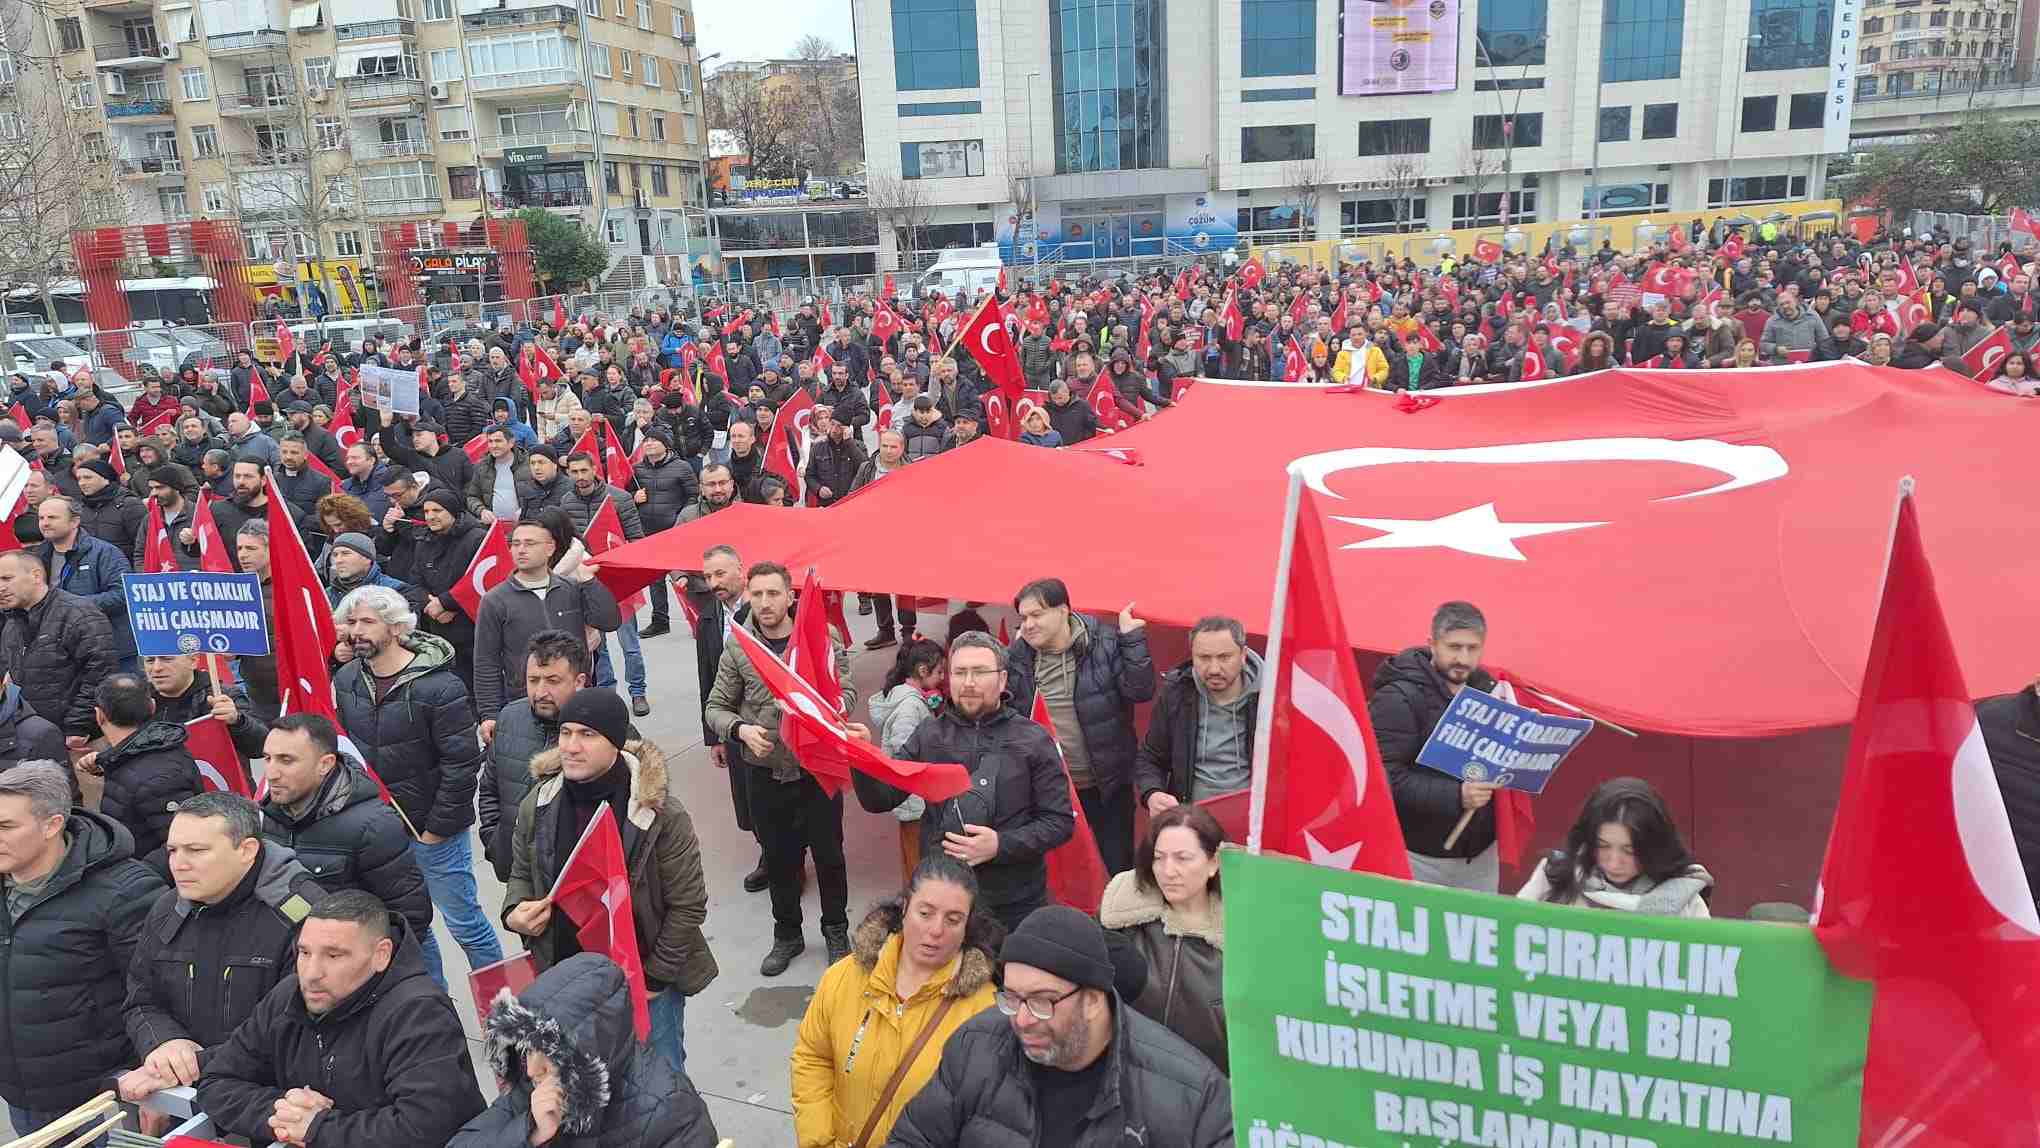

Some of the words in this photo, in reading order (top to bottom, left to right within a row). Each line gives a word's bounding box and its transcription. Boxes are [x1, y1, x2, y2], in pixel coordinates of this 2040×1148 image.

[132, 583, 166, 602] STAJ
[168, 581, 188, 601] VE
[190, 581, 254, 606] ÇIRAKLIK
[135, 607, 169, 631] FİİLİ
[171, 610, 260, 635] ÇALIŞMADIR
[1437, 721, 1480, 751] FİİLİ
[1456, 698, 1497, 726] STAJ
[1494, 711, 1521, 735] VE
[1321, 890, 1429, 956] STAJ
[1443, 910, 1499, 967] VE
[1514, 922, 1742, 998] ÇIRAKLIK
[1324, 950, 1498, 1031] İŞLETME
[1512, 990, 1630, 1054] VEYA
[1646, 1004, 1732, 1067] BİR
[1275, 1014, 1484, 1091] KURUMDA
[1497, 1043, 1545, 1106] İŞ
[1559, 1062, 1794, 1142] HAYATINA
[1374, 1089, 1659, 1148] BAŞLAMA
